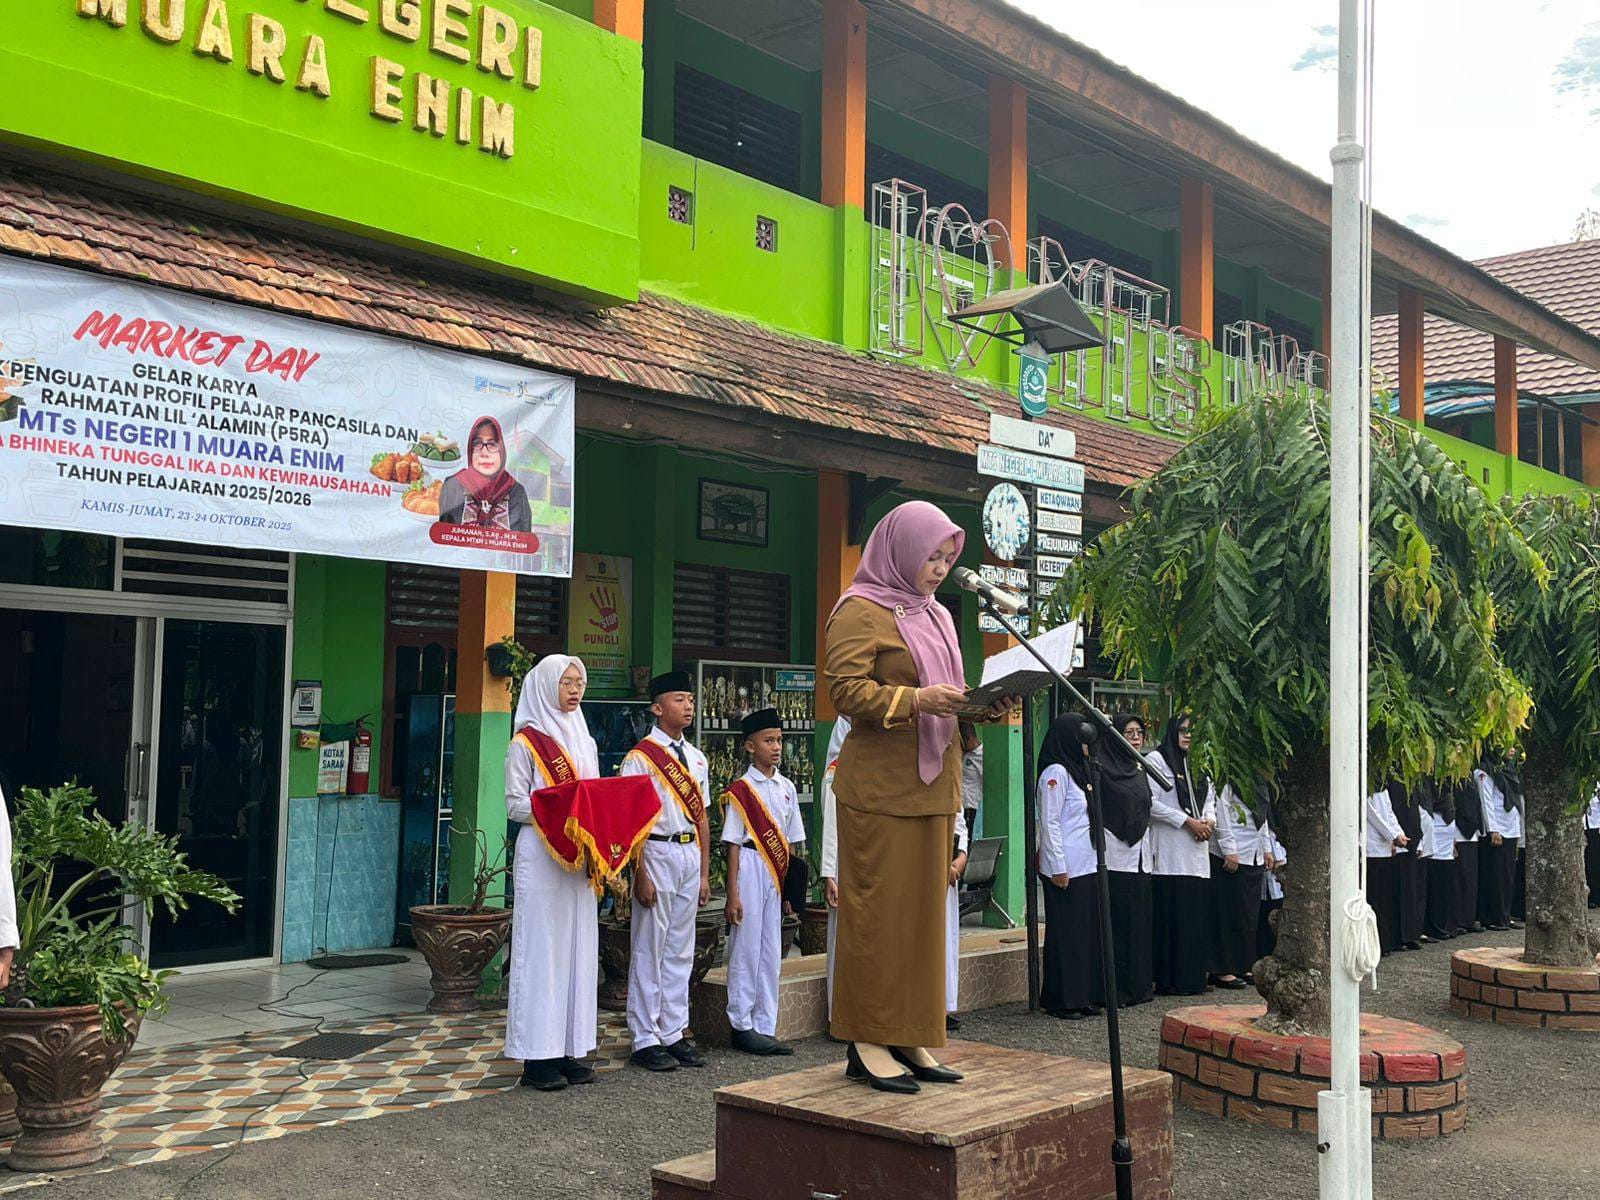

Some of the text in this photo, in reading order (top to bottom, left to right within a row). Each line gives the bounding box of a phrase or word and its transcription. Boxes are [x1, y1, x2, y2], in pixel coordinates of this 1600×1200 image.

[324, 0, 542, 90] GERI
[370, 56, 514, 159] ENIM
[73, 310, 321, 382] MARKET DAY
[11, 362, 138, 397] PENGUATAN
[143, 384, 205, 409] PROFIL
[211, 396, 284, 421] PELAJAR
[289, 409, 381, 437] PANCASILA
[385, 425, 418, 442] DAN
[133, 363, 258, 397] GELAR KARYA
[19, 408, 344, 473] MTs NEGERI 1 MUARA ENIM
[41, 388, 159, 421] RAHMATAN
[164, 409, 187, 425] LIL
[271, 422, 329, 450] (P5RA)
[9, 434, 95, 459] BHINEKA
[100, 446, 184, 470] TUNGGAL
[189, 458, 216, 474] IKA
[220, 463, 255, 480] DAN
[258, 468, 391, 498] KEWIRAUSAHAAN
[56, 462, 311, 507] TAHUN PELAJARAN 2025/2026
[80, 499, 292, 531] KAMIS-JUMAT, 23-24 OKTOBER 2025
[441, 534, 465, 543] KEPALA
[488, 539, 511, 548] MUARA
[512, 541, 528, 549] ENIM
[584, 634, 619, 645] PUNGLI
[600, 612, 618, 629] STOP
[323, 748, 345, 759] KOTAK
